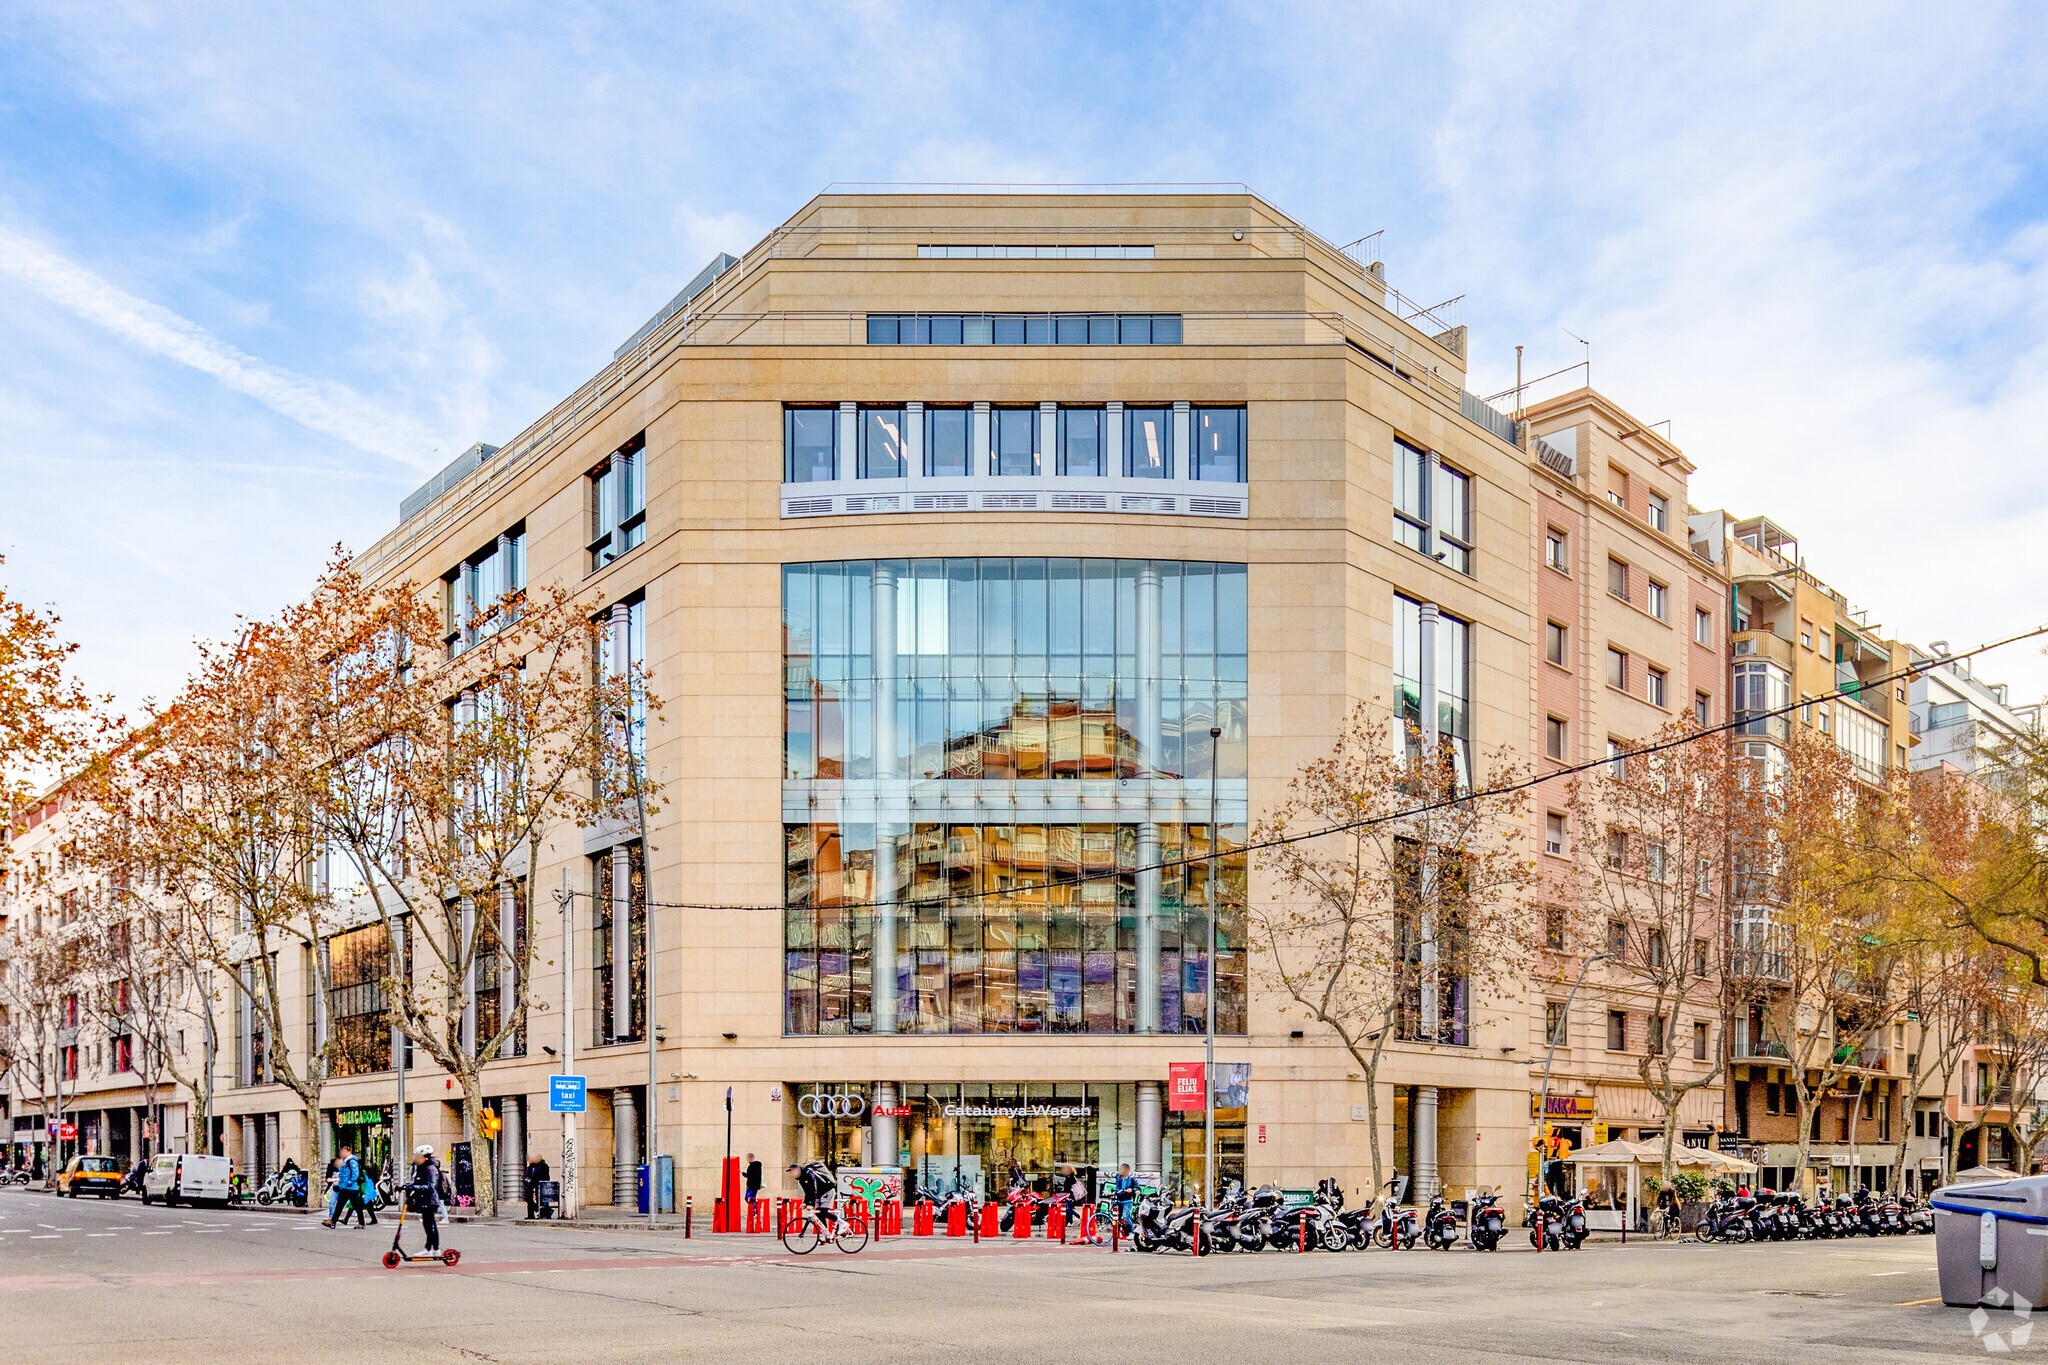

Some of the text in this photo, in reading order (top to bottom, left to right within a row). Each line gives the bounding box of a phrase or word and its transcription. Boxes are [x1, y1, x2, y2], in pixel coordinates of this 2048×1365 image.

[561, 1091, 575, 1099] taxi
[1177, 1085, 1197, 1093] ELIAS
[873, 1104, 911, 1116] Audi
[944, 1104, 1091, 1119] Catalunya Wagen
[1546, 1097, 1577, 1116] BARÇA
